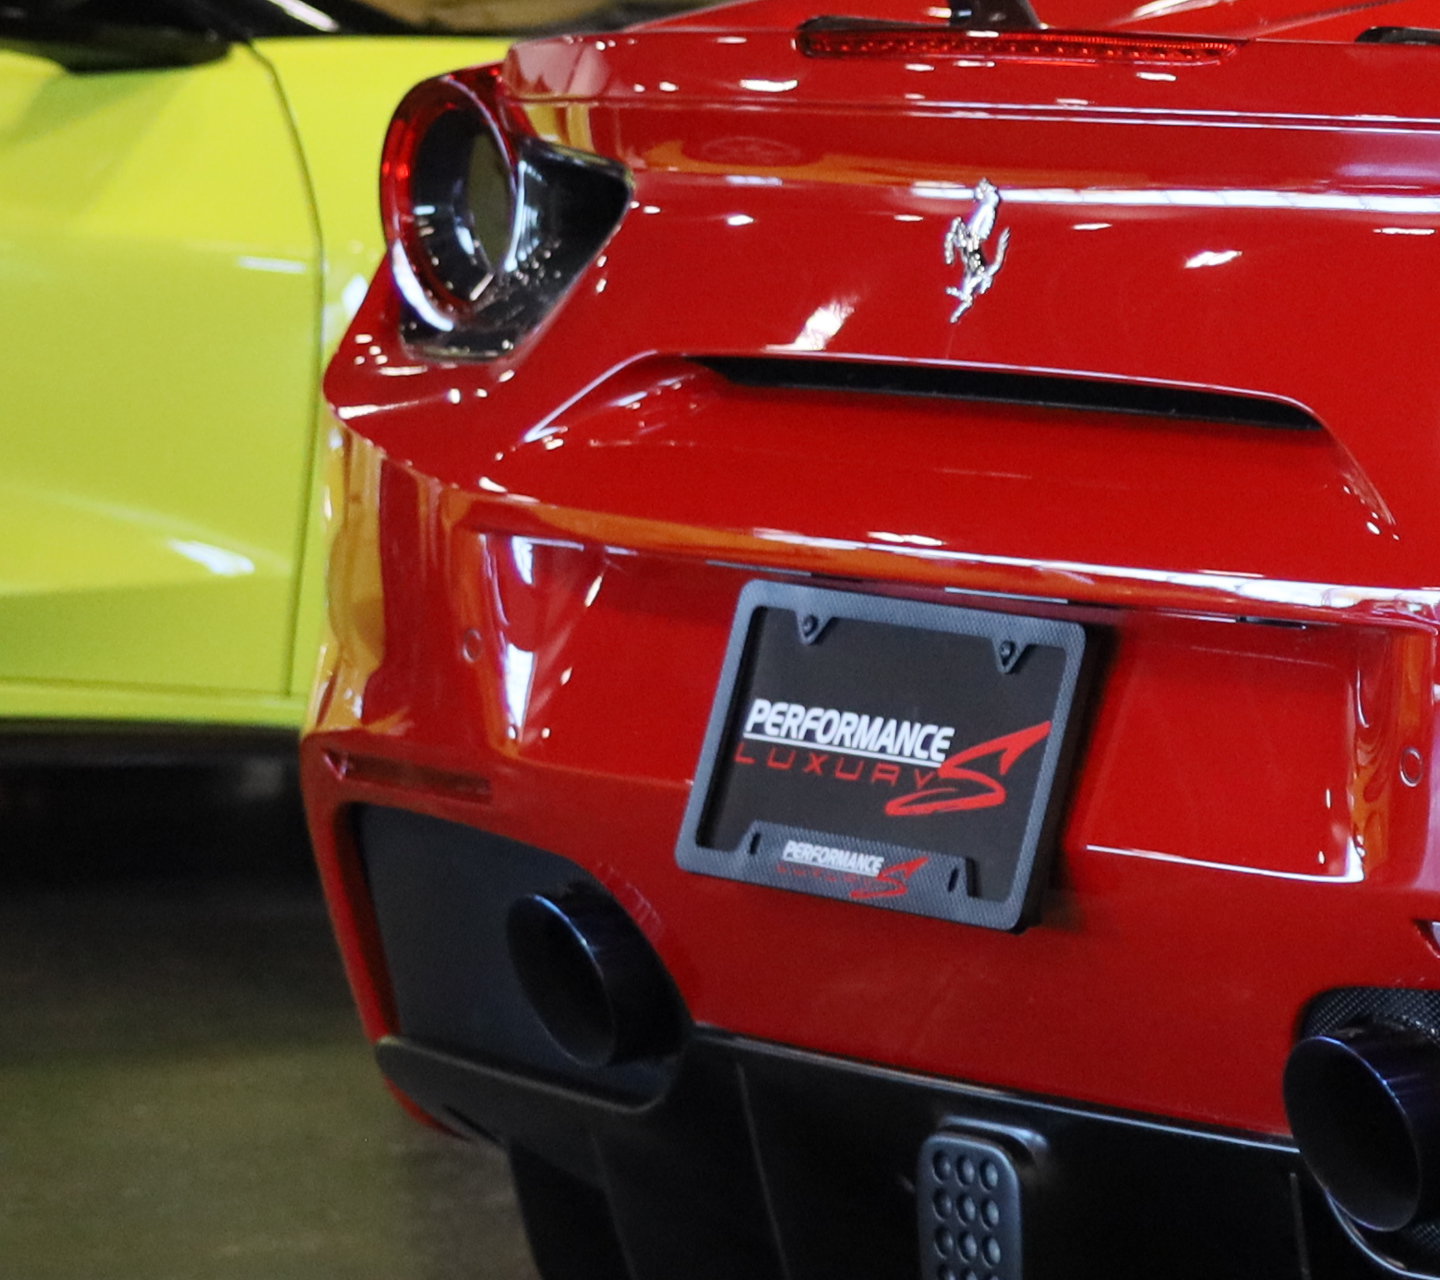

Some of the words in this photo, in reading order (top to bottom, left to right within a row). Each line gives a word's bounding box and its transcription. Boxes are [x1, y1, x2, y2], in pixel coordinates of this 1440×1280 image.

[744, 698, 955, 762] PERFORMANCE
[734, 742, 935, 789] LUXURY
[782, 839, 885, 875] PERFORMANCE
